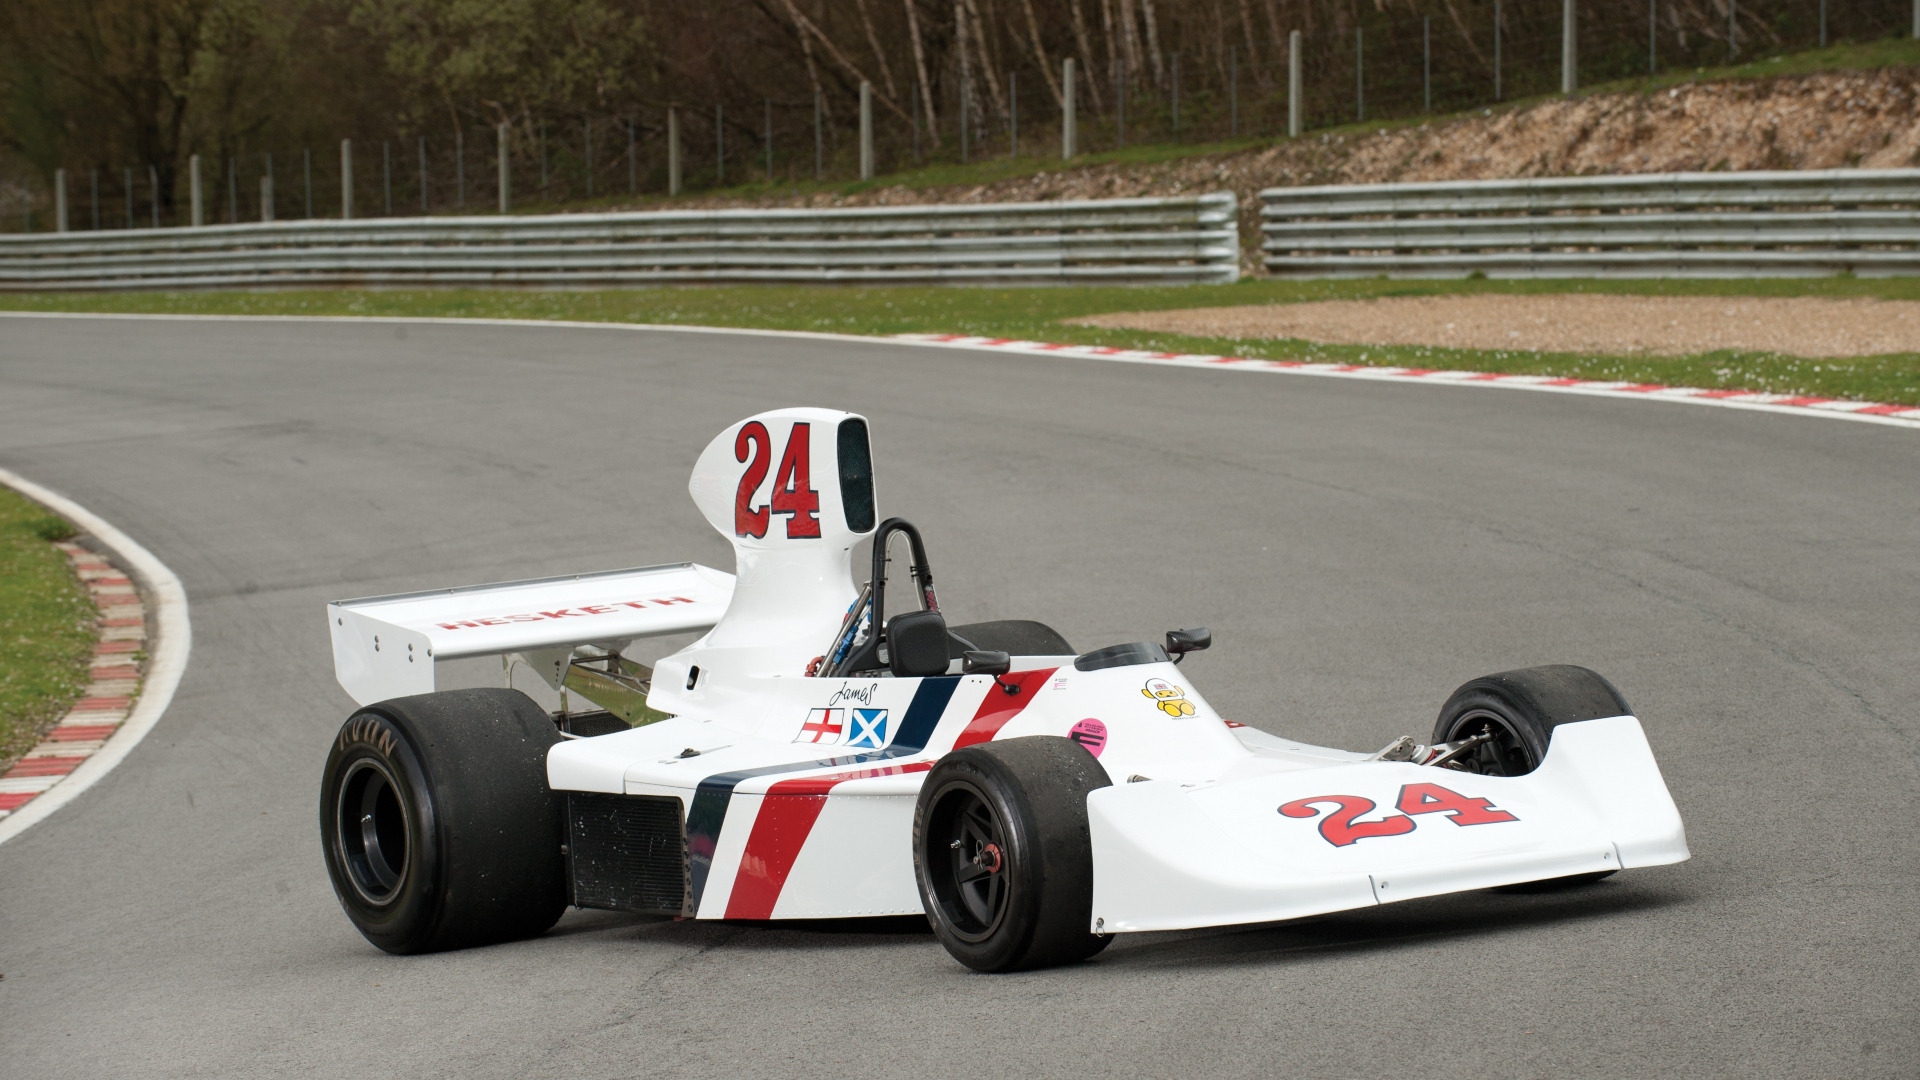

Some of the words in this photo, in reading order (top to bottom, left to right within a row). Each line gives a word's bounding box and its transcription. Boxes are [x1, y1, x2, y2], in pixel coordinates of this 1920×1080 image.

[735, 420, 822, 539] 24
[434, 596, 698, 630] HESKETH
[1277, 782, 1521, 848] 24
